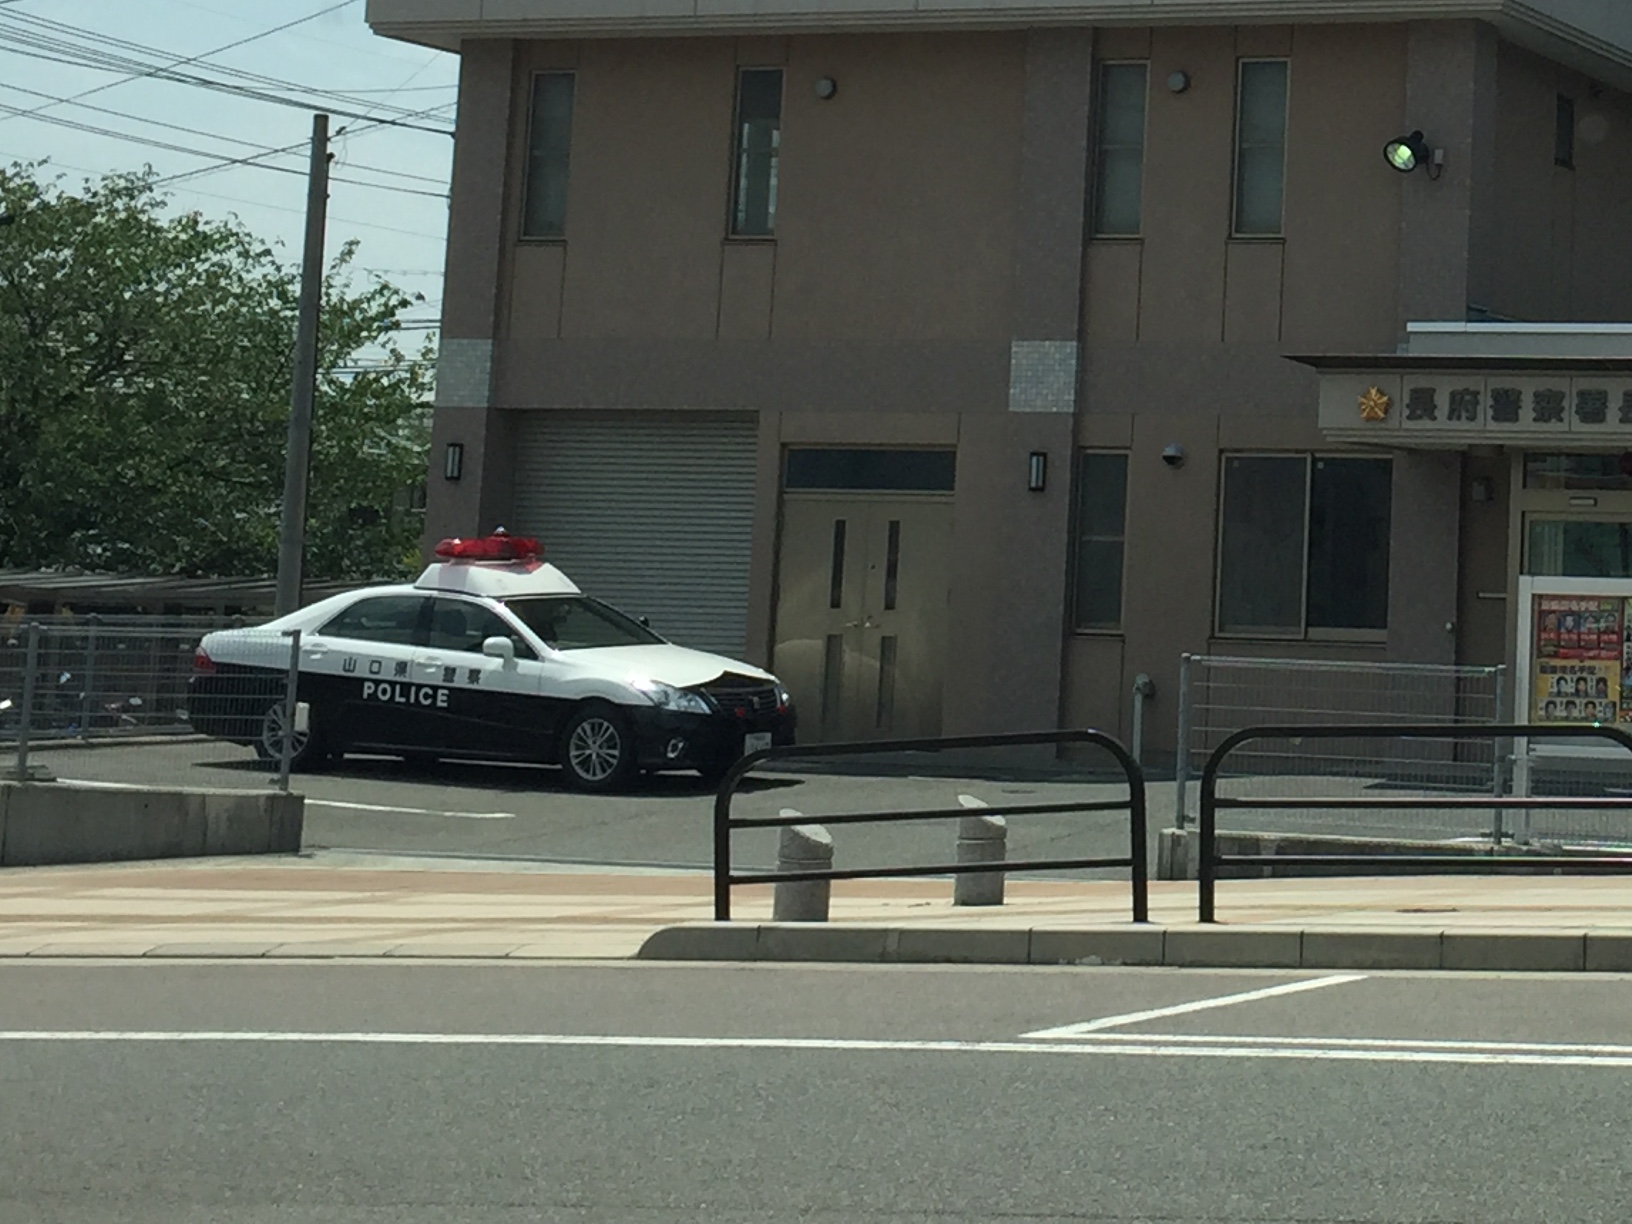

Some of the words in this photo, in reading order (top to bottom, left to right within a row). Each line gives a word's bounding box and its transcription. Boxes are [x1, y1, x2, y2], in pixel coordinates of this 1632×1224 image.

[342, 656, 408, 678] 山口県
[362, 681, 450, 708] POLICE
